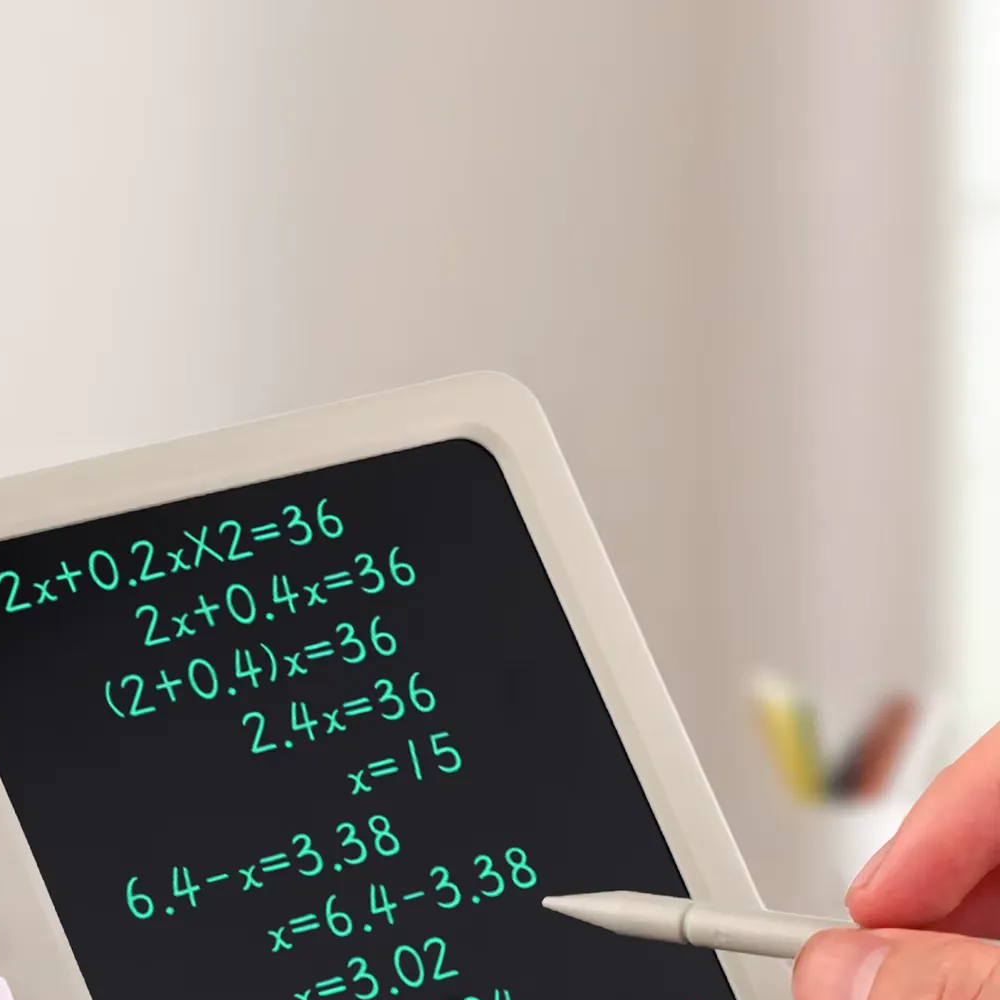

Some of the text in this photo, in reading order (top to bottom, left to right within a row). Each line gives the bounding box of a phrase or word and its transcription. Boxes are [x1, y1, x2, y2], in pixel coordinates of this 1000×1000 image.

[135, 546, 416, 647] 2x+0.4x=36
[105, 615, 397, 718] (2+0.4)x=36
[241, 671, 436, 754] 2.4x=36
[347, 731, 462, 795] x=15
